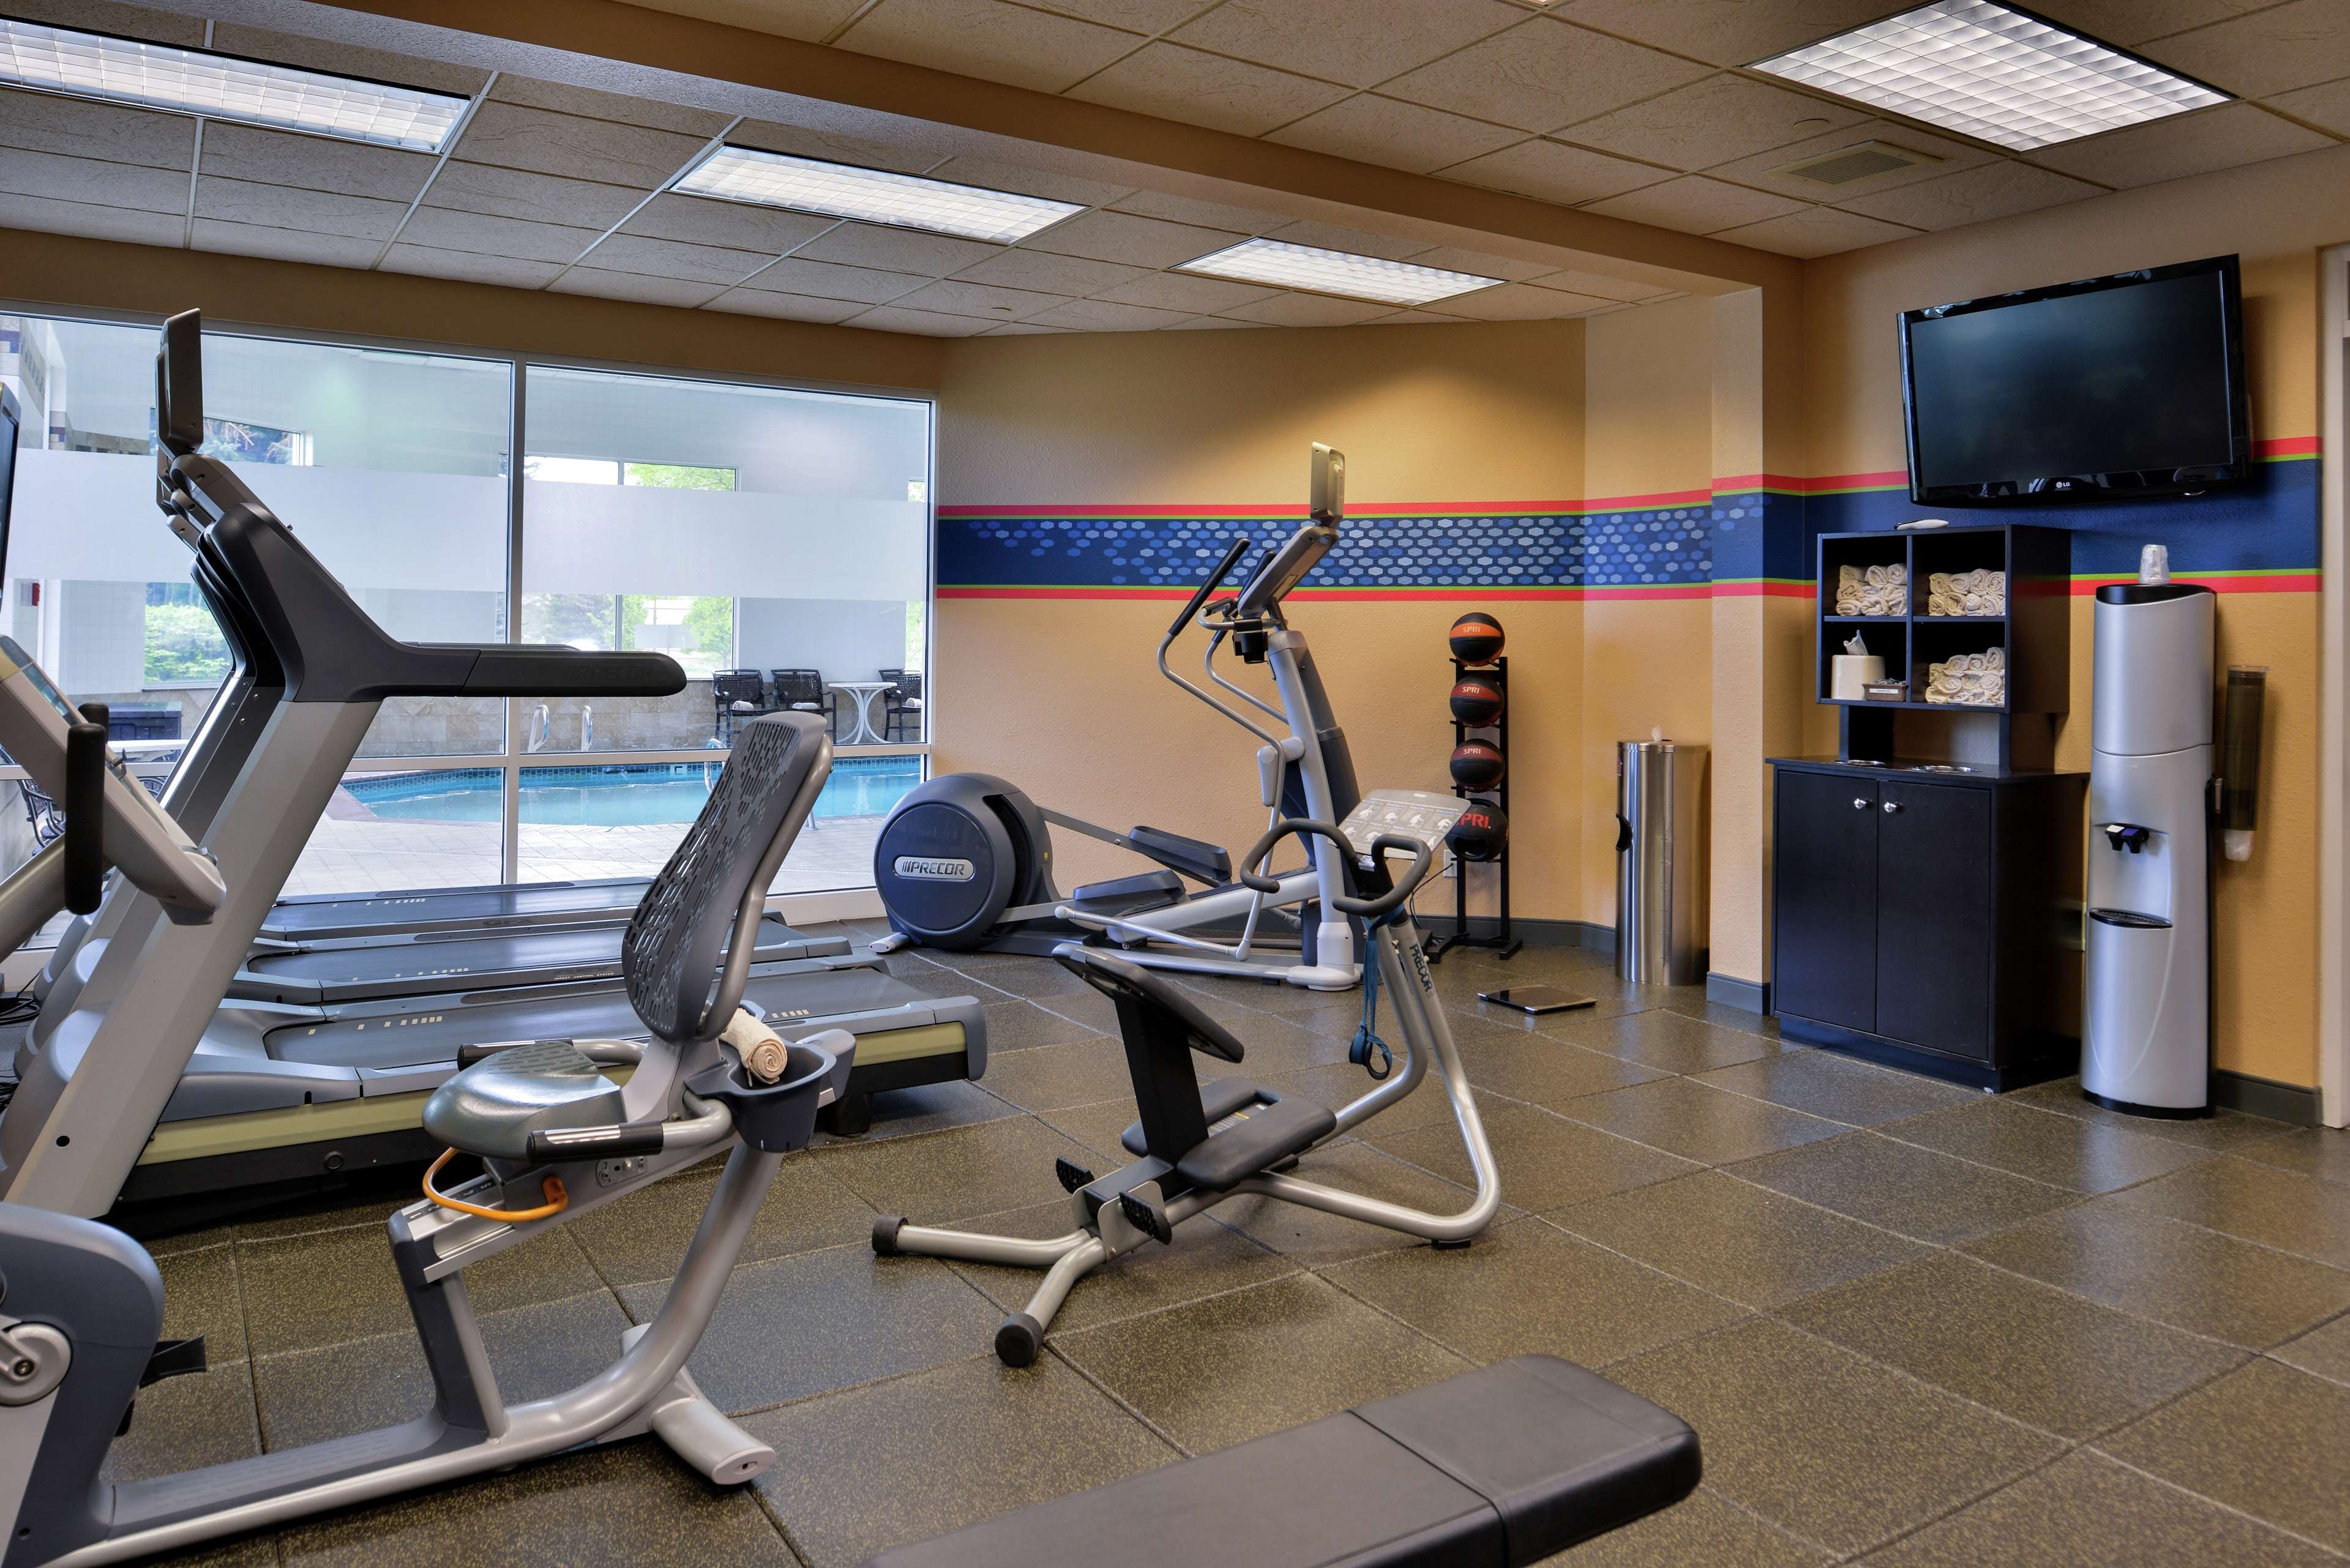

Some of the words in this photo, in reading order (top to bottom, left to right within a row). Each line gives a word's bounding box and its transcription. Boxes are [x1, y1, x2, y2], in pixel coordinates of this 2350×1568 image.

[1456, 812, 1489, 829] PRI
[908, 861, 965, 875] PRECOR
[1409, 944, 1432, 992] PRECOR
